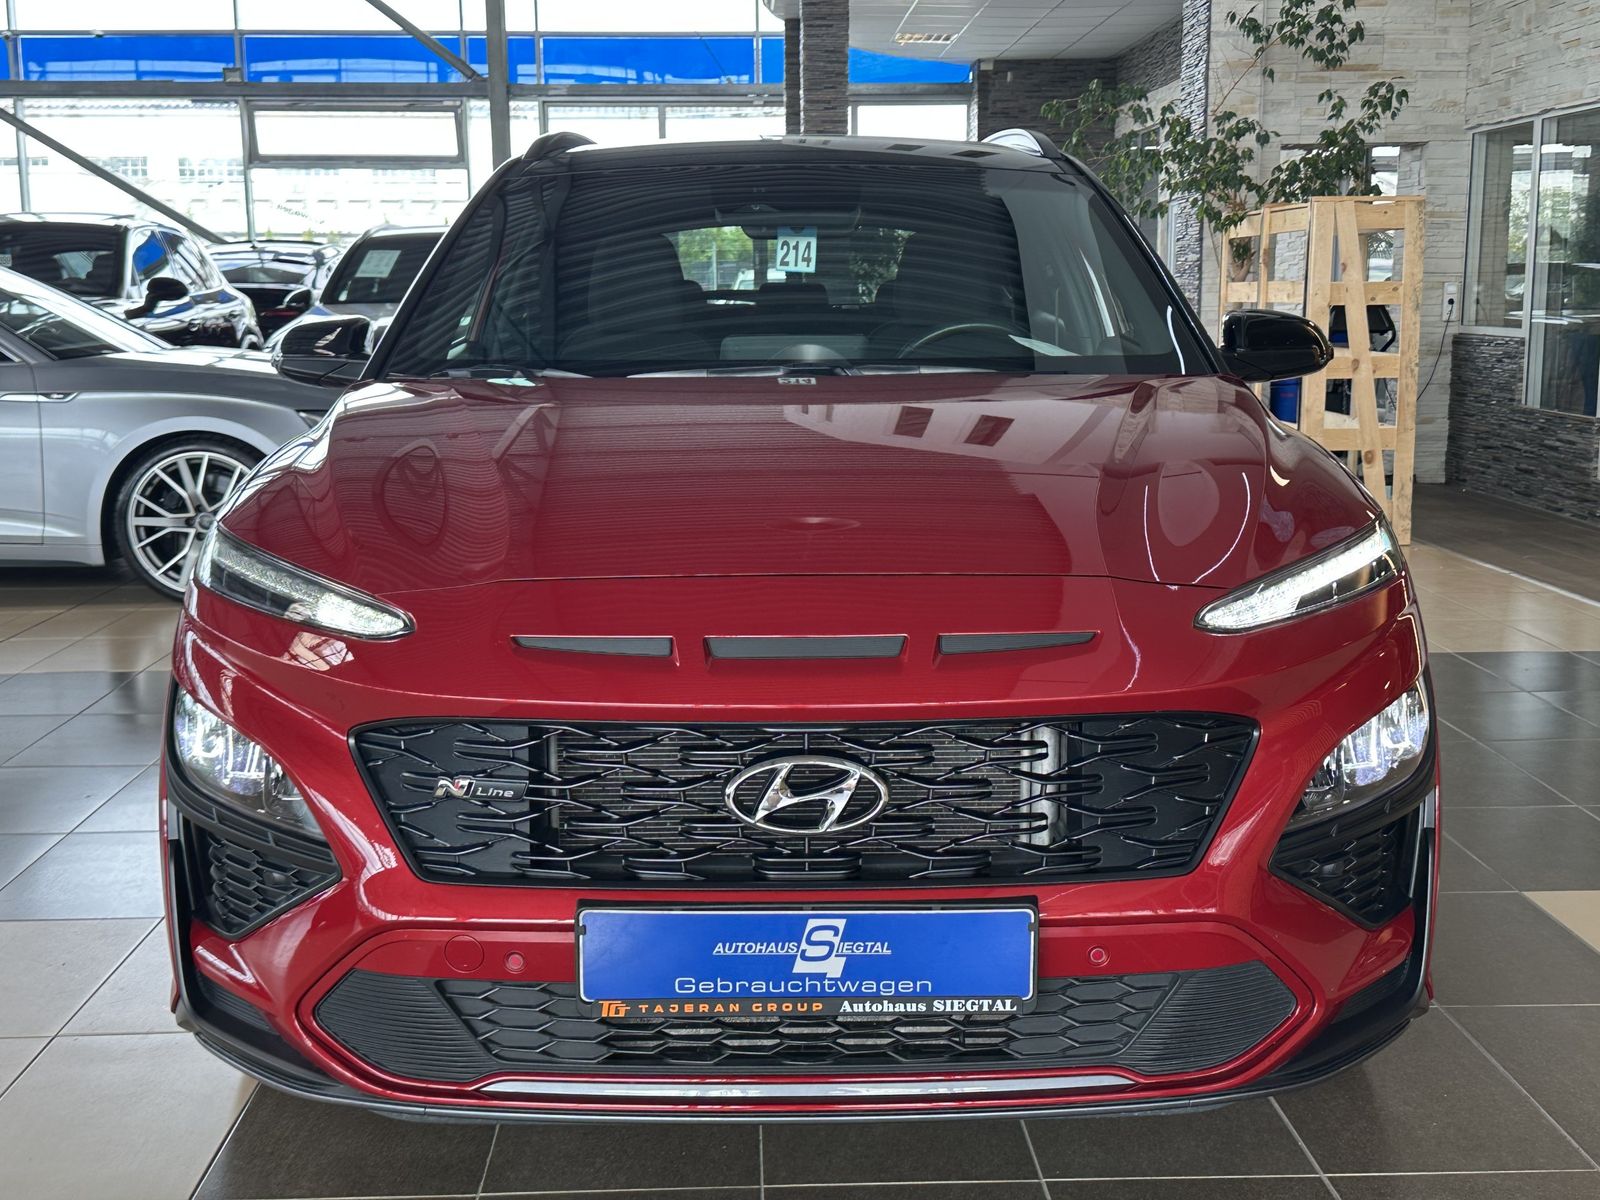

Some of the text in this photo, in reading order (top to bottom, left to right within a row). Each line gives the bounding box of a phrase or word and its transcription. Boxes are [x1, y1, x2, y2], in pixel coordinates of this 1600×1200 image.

[779, 239, 812, 267] 214
[476, 787, 514, 798] Line
[712, 942, 799, 954] AUTOHAUS
[674, 976, 932, 996] Gebrauchtwagen
[638, 1003, 740, 1014] TAJERAN
[751, 1002, 824, 1013] GROUP
[839, 1000, 927, 1013] Autohaus
[932, 999, 1017, 1013] SIEGTAL
